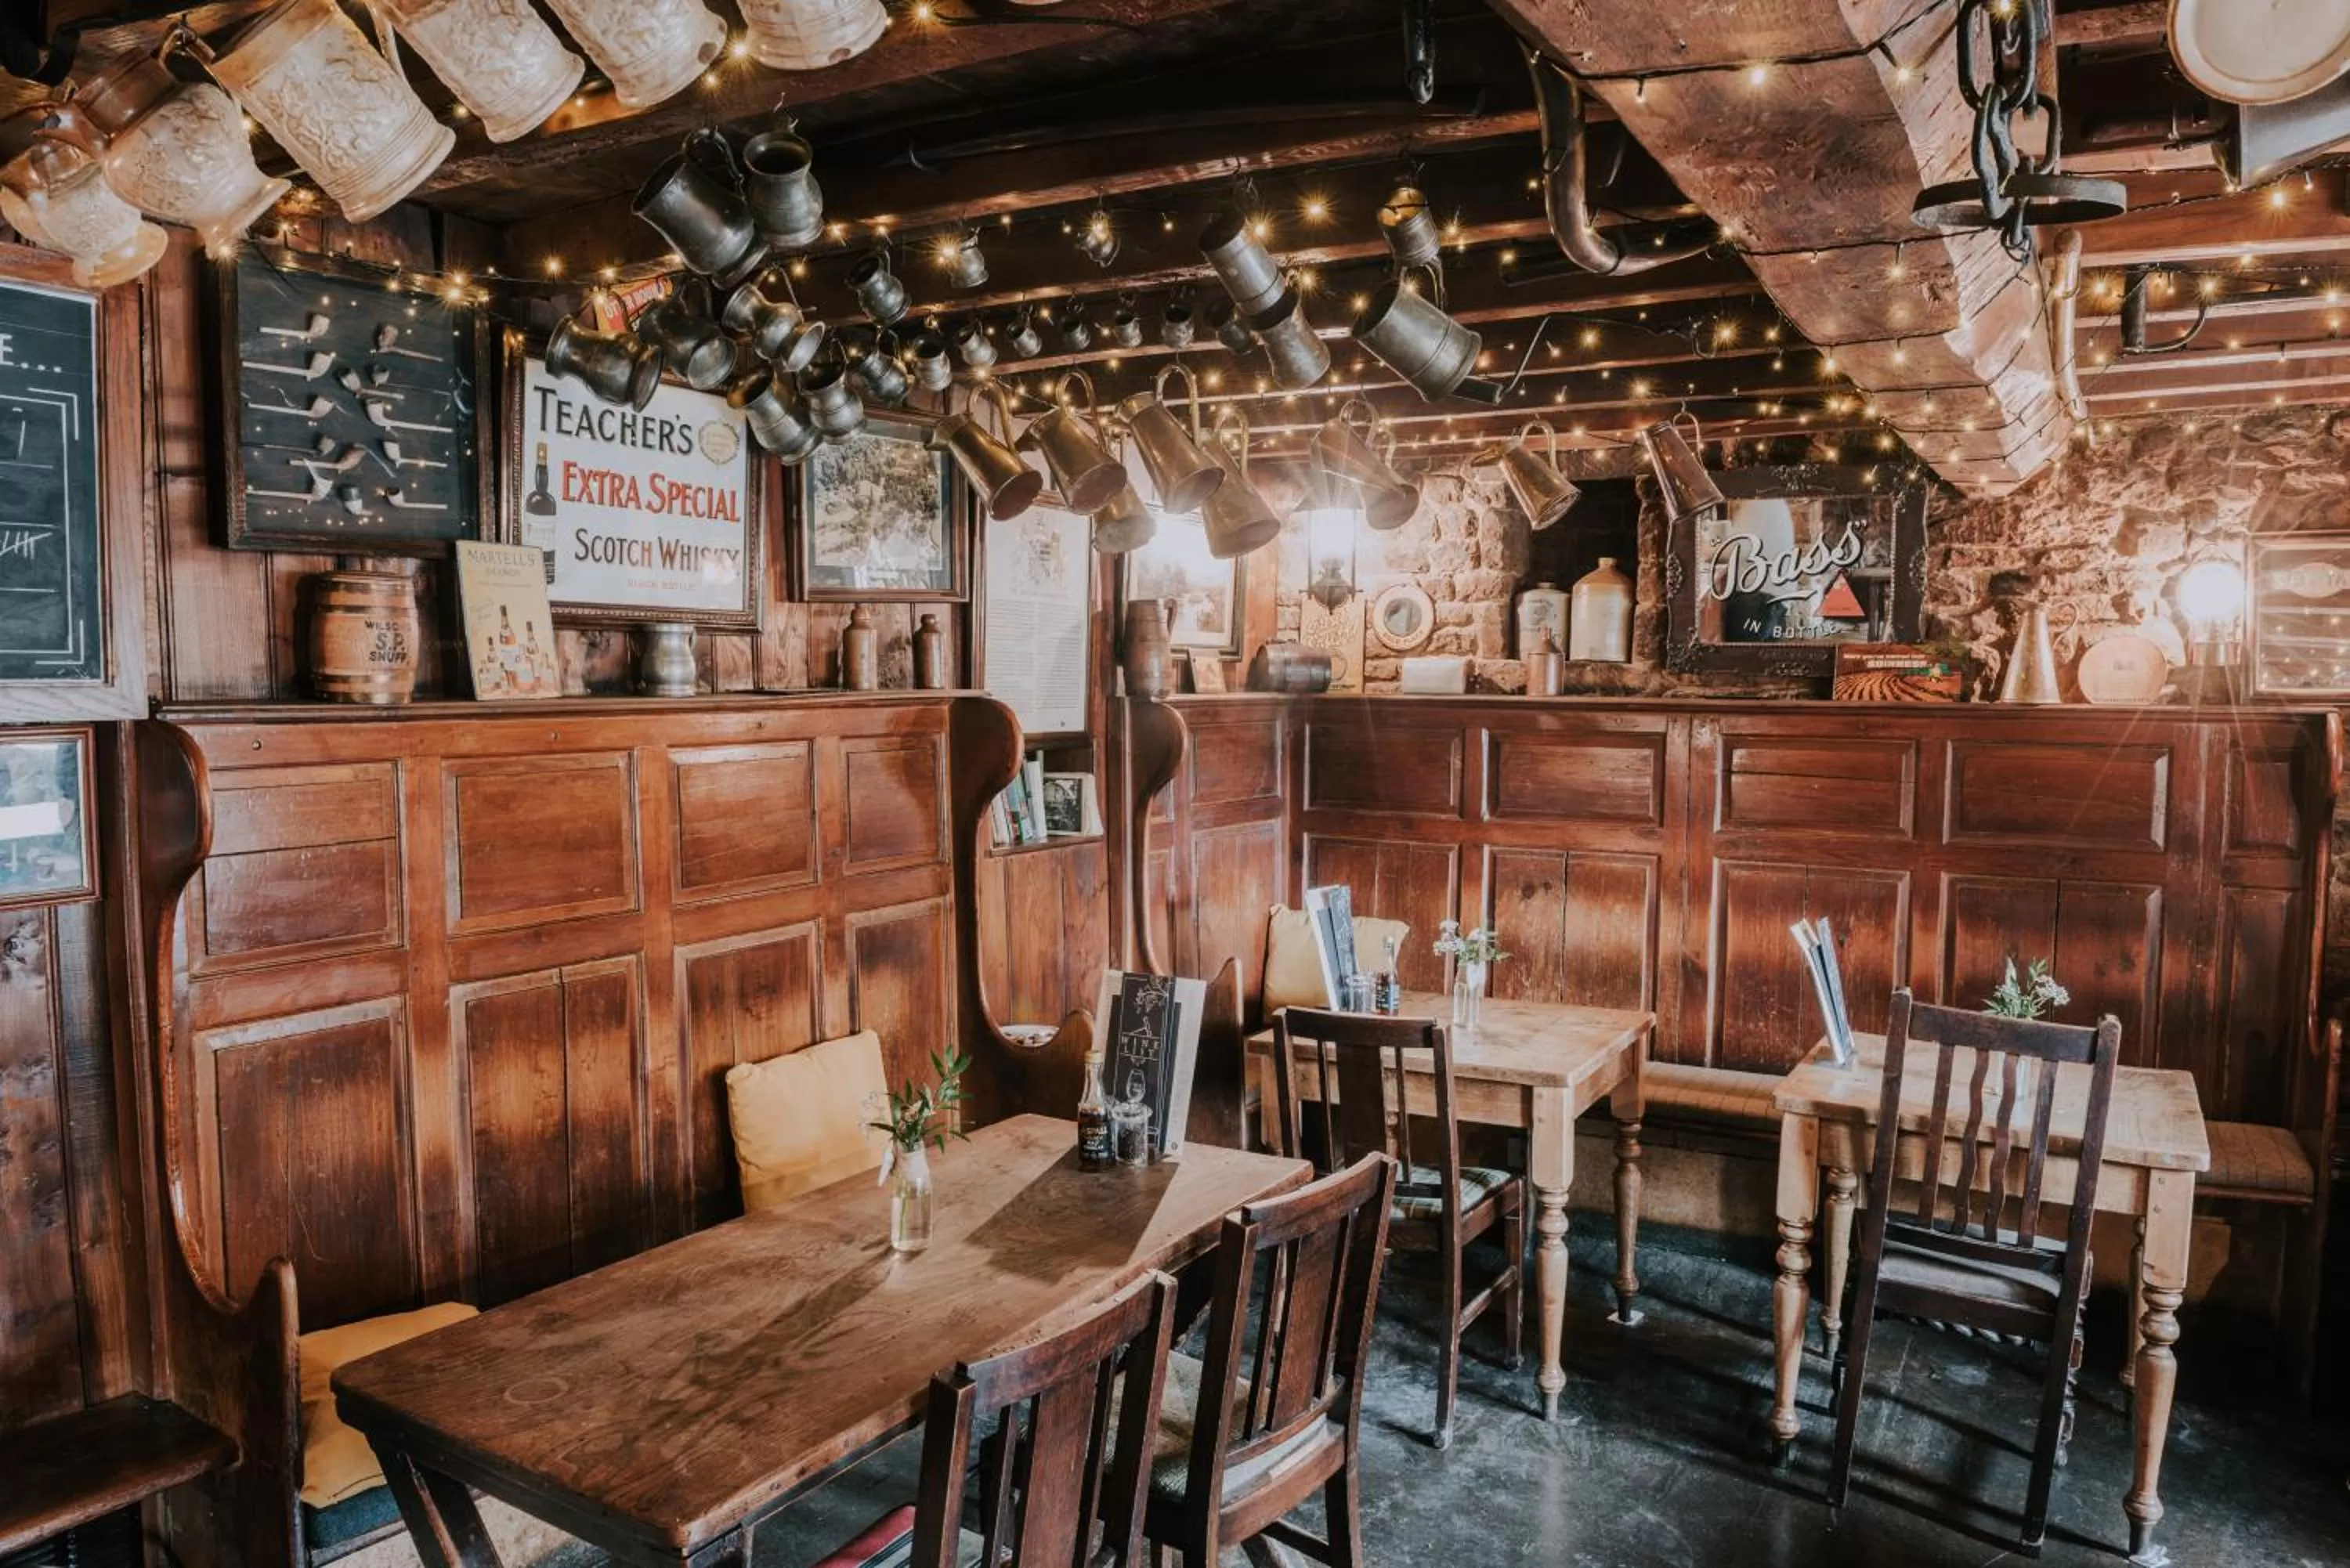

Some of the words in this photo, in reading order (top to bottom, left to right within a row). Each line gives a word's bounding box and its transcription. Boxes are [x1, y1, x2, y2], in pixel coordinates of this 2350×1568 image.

[533, 385, 693, 455] TEACHER'S
[562, 460, 642, 510] EXTRA
[645, 471, 740, 522] SPECIAL
[575, 528, 653, 569] SCOTCH
[1743, 618, 1761, 633] IN
